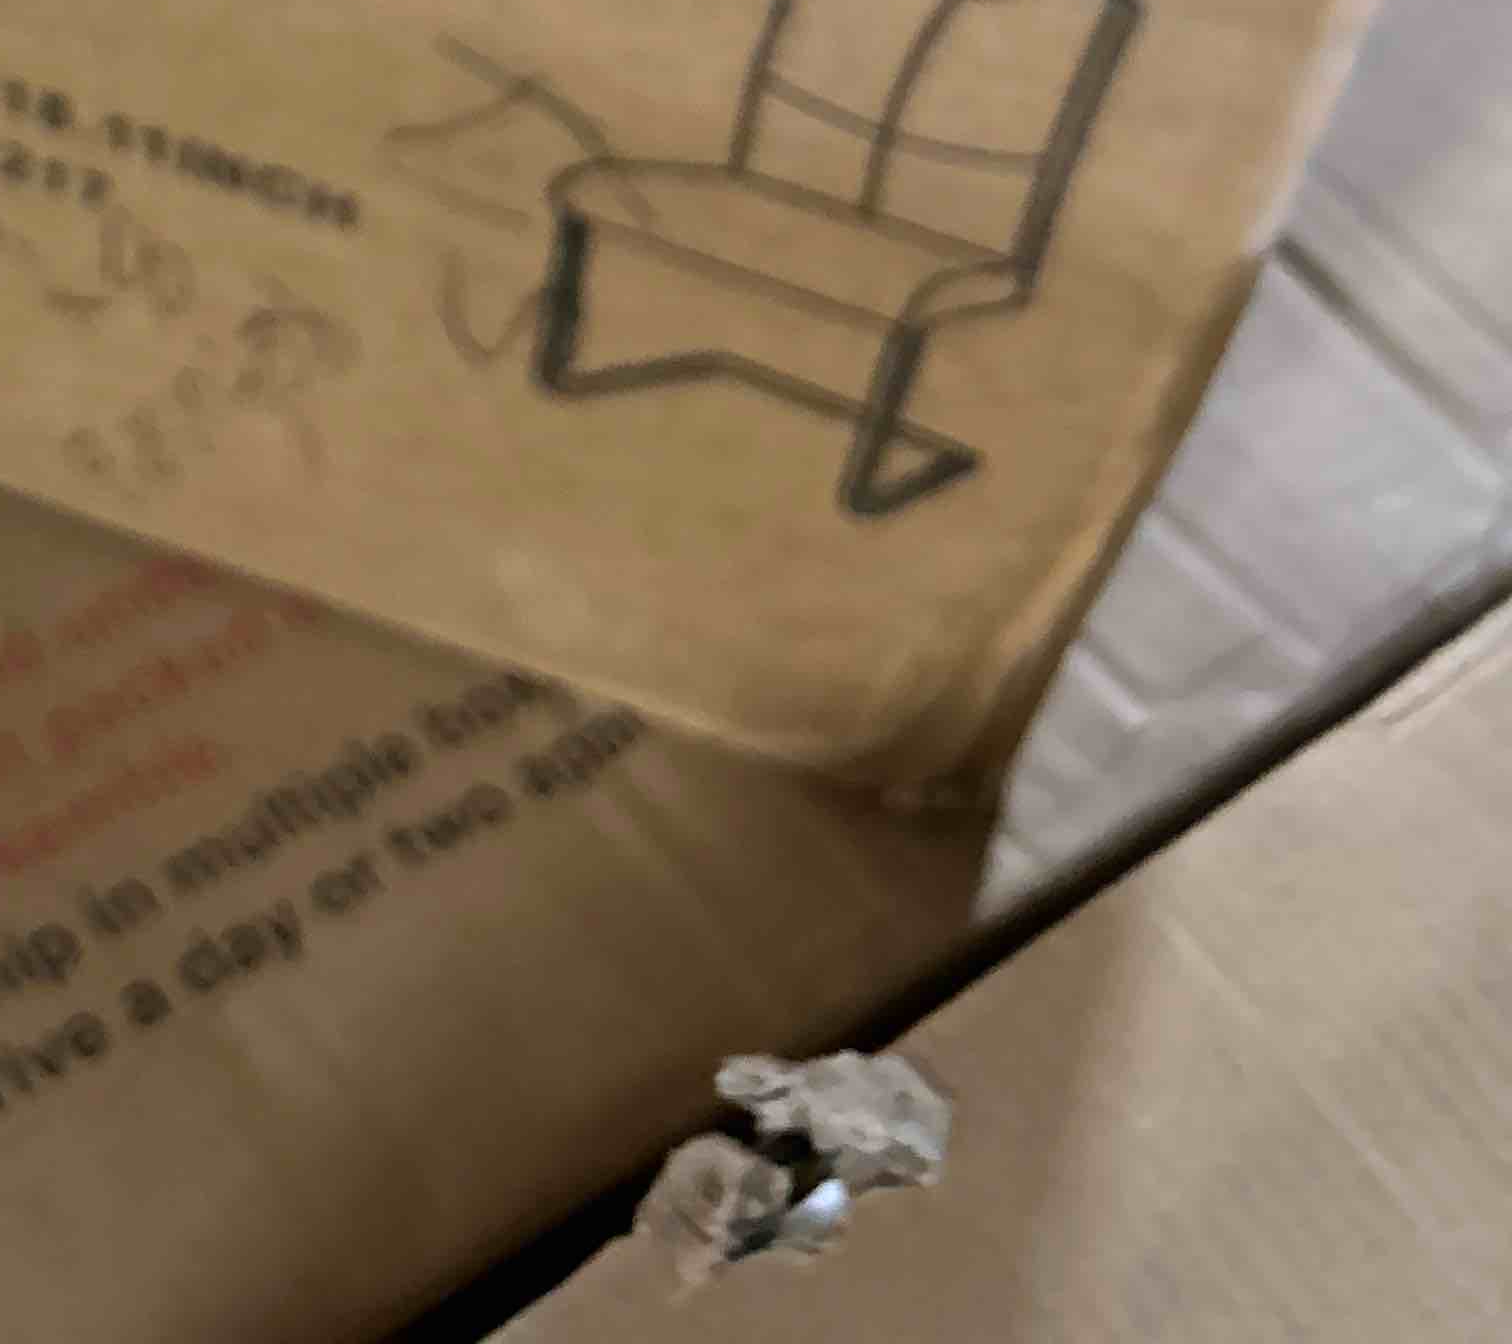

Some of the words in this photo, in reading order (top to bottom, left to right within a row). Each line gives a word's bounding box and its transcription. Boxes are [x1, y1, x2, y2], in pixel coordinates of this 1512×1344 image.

[78, 874, 162, 939] in
[164, 730, 420, 894] multiple
[122, 979, 173, 1030] a
[180, 900, 305, 996] day
[308, 851, 387, 916] or
